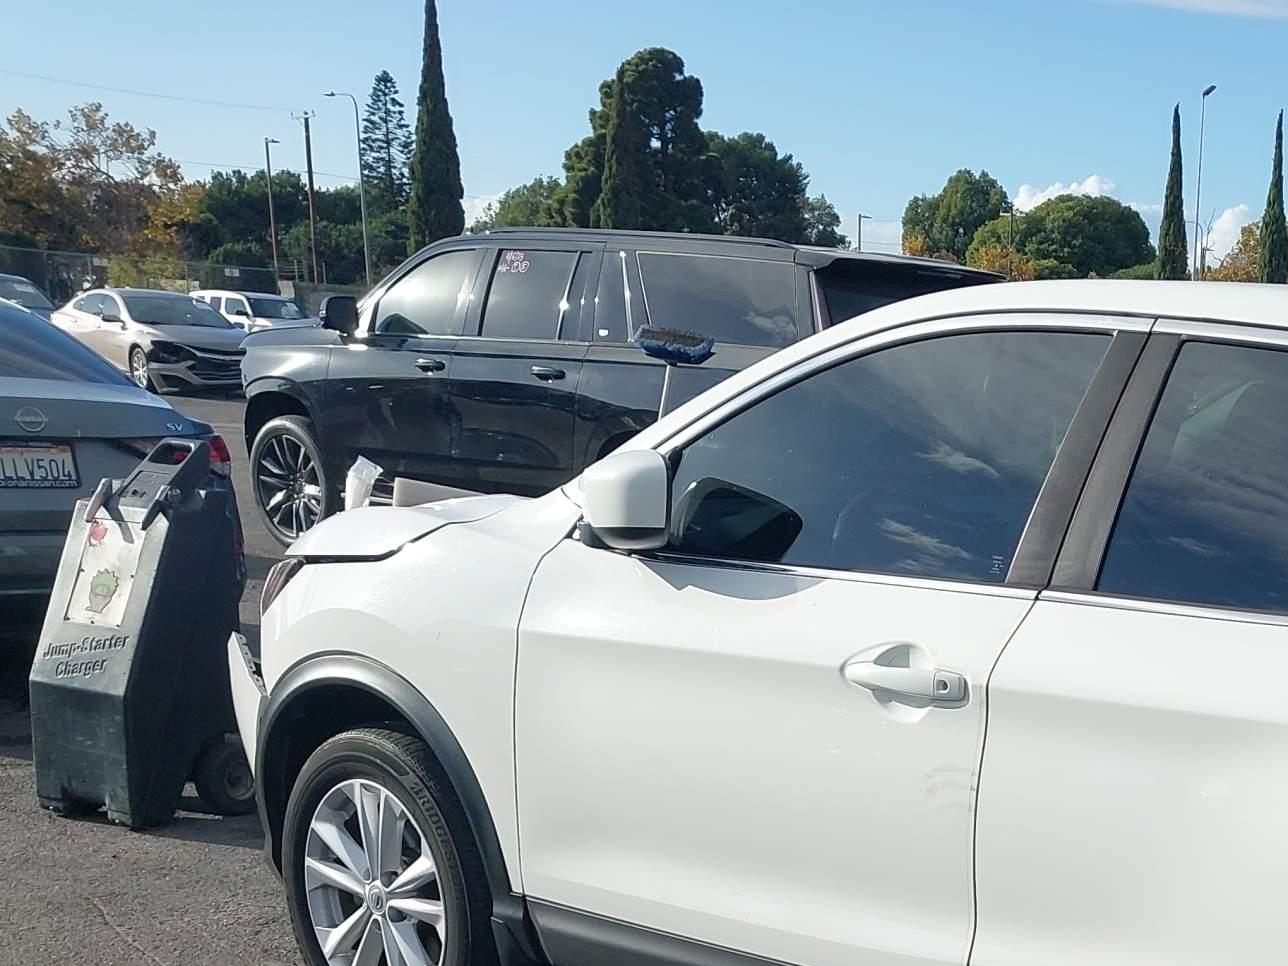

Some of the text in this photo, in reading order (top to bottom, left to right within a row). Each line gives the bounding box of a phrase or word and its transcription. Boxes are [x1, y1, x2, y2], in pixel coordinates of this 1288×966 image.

[166, 423, 183, 431] SV
[43, 633, 130, 660] Jump-Starter
[56, 658, 107, 679] Charger
